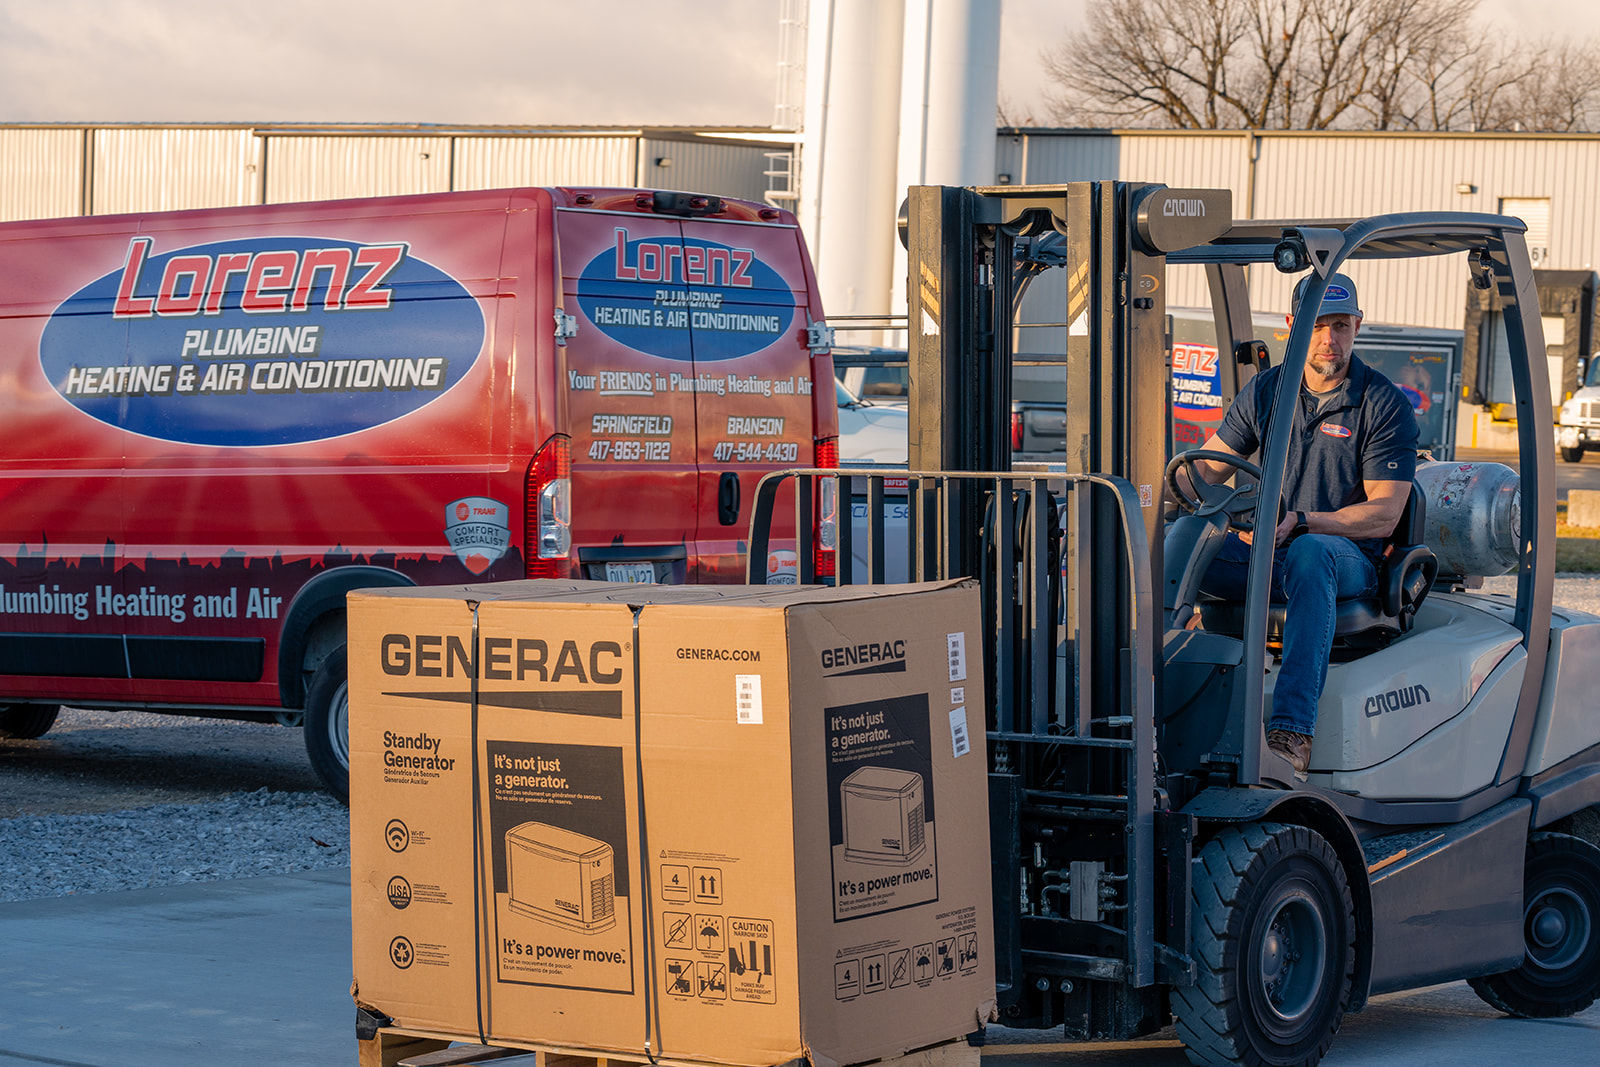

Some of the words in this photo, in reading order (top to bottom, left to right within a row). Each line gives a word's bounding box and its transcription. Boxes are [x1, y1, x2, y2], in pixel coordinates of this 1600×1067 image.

[1163, 199, 1205, 216] CROWN
[614, 227, 755, 288] Lorenz
[112, 237, 410, 318] Lorenz
[653, 290, 723, 308] PLUMBING
[595, 307, 650, 326] HEATING
[653, 312, 663, 326] &
[666, 311, 688, 327] AIR
[692, 313, 779, 332] CONDITIONING
[181, 326, 321, 357] PLUMBING
[66, 365, 172, 394] HEATING
[176, 365, 196, 392] &
[200, 363, 246, 391] AIR
[250, 358, 443, 390] CONDITIONING
[568, 370, 596, 390] Your
[600, 371, 652, 391] FRIENDS
[655, 373, 667, 391] in
[670, 373, 725, 396] Plumbing
[728, 375, 771, 397] Heating
[774, 377, 794, 395] and
[797, 377, 812, 395] Air
[592, 416, 672, 434] SPRINGFIELD
[727, 417, 784, 435] BRANSON
[588, 441, 671, 461] 417-863-1122
[713, 443, 798, 462] 417-544-4430
[455, 526, 500, 536] COMFORT
[454, 536, 505, 547] SPECIALIST
[0, 584, 89, 620] lumbing
[96, 585, 187, 623] Heating
[193, 587, 237, 618] and
[246, 587, 282, 618] Air
[381, 633, 623, 684] GENERAC
[676, 648, 761, 662] GENERAC.COM
[821, 640, 906, 668] GENERAC
[1365, 684, 1431, 718] CROWN
[849, 714, 864, 729] not
[866, 711, 884, 729] just
[384, 731, 441, 754] Standby
[832, 737, 839, 748] a
[840, 729, 891, 750] generator.
[384, 750, 455, 771] Generator
[514, 757, 535, 770] not
[537, 756, 560, 774] just
[495, 774, 502, 785] a
[505, 774, 569, 789] generator.
[672, 874, 679, 885] 4
[858, 882, 865, 893] a
[867, 875, 901, 895] power
[903, 868, 933, 884] move.
[390, 885, 408, 897] USA
[732, 921, 769, 933] CAUTION
[525, 944, 533, 956] a
[536, 945, 580, 960] power
[583, 949, 626, 964] move.
[844, 969, 851, 981] 4
